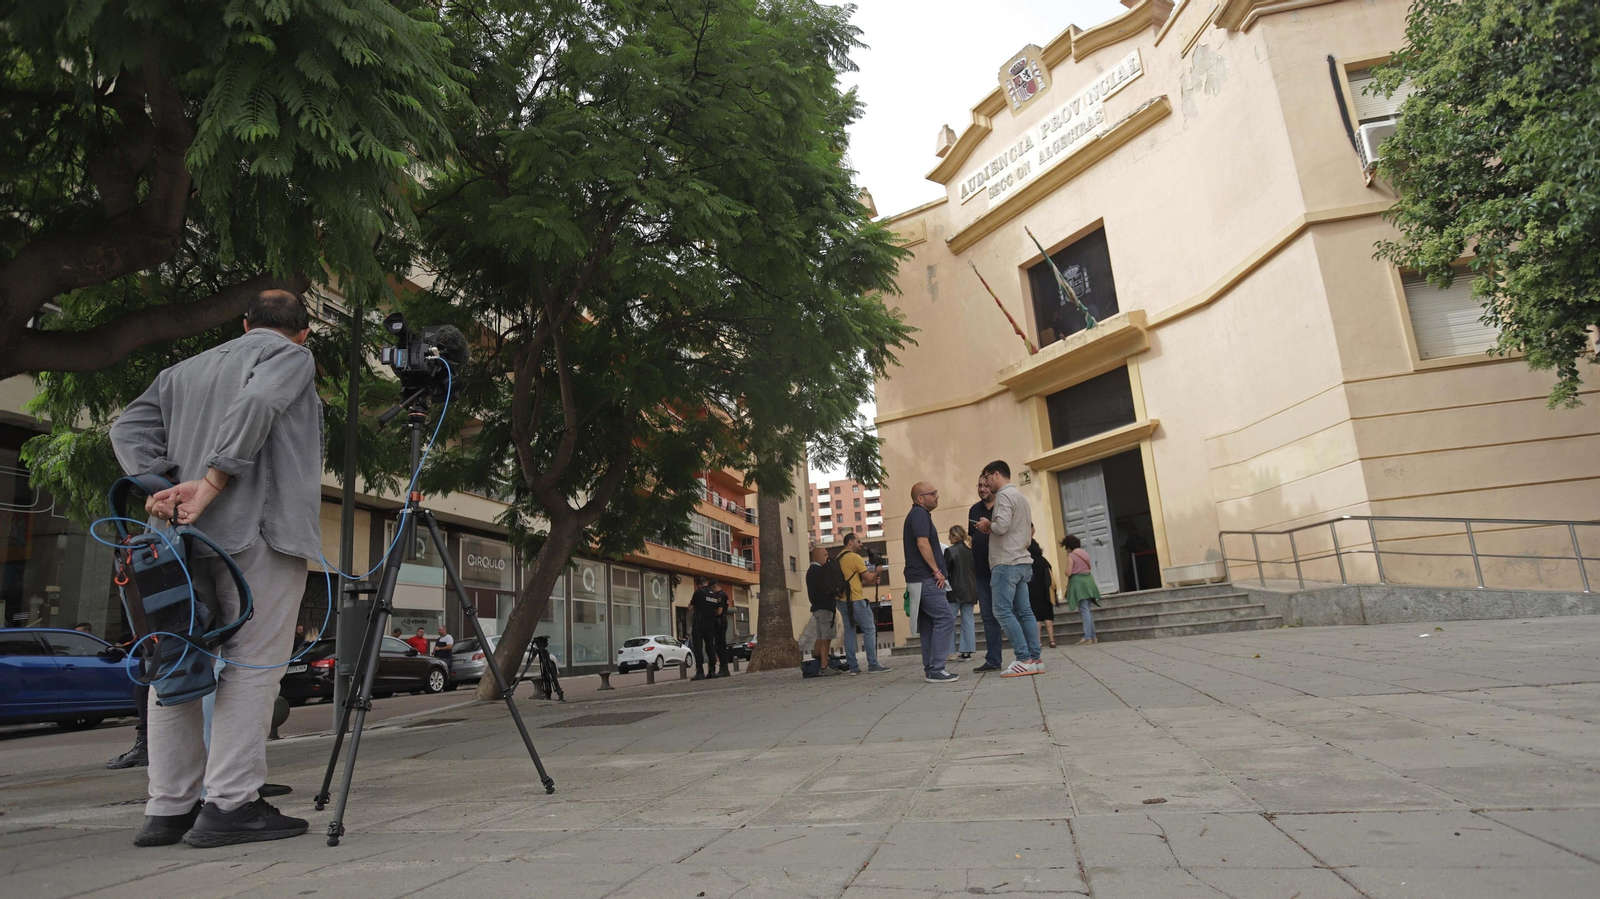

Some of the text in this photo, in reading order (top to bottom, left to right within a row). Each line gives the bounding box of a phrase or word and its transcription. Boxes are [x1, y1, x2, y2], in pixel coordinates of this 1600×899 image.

[1038, 108, 1105, 165] ALGECIRAS
[960, 135, 1035, 200] AUDIENCIA
[582, 567, 596, 593] Q
